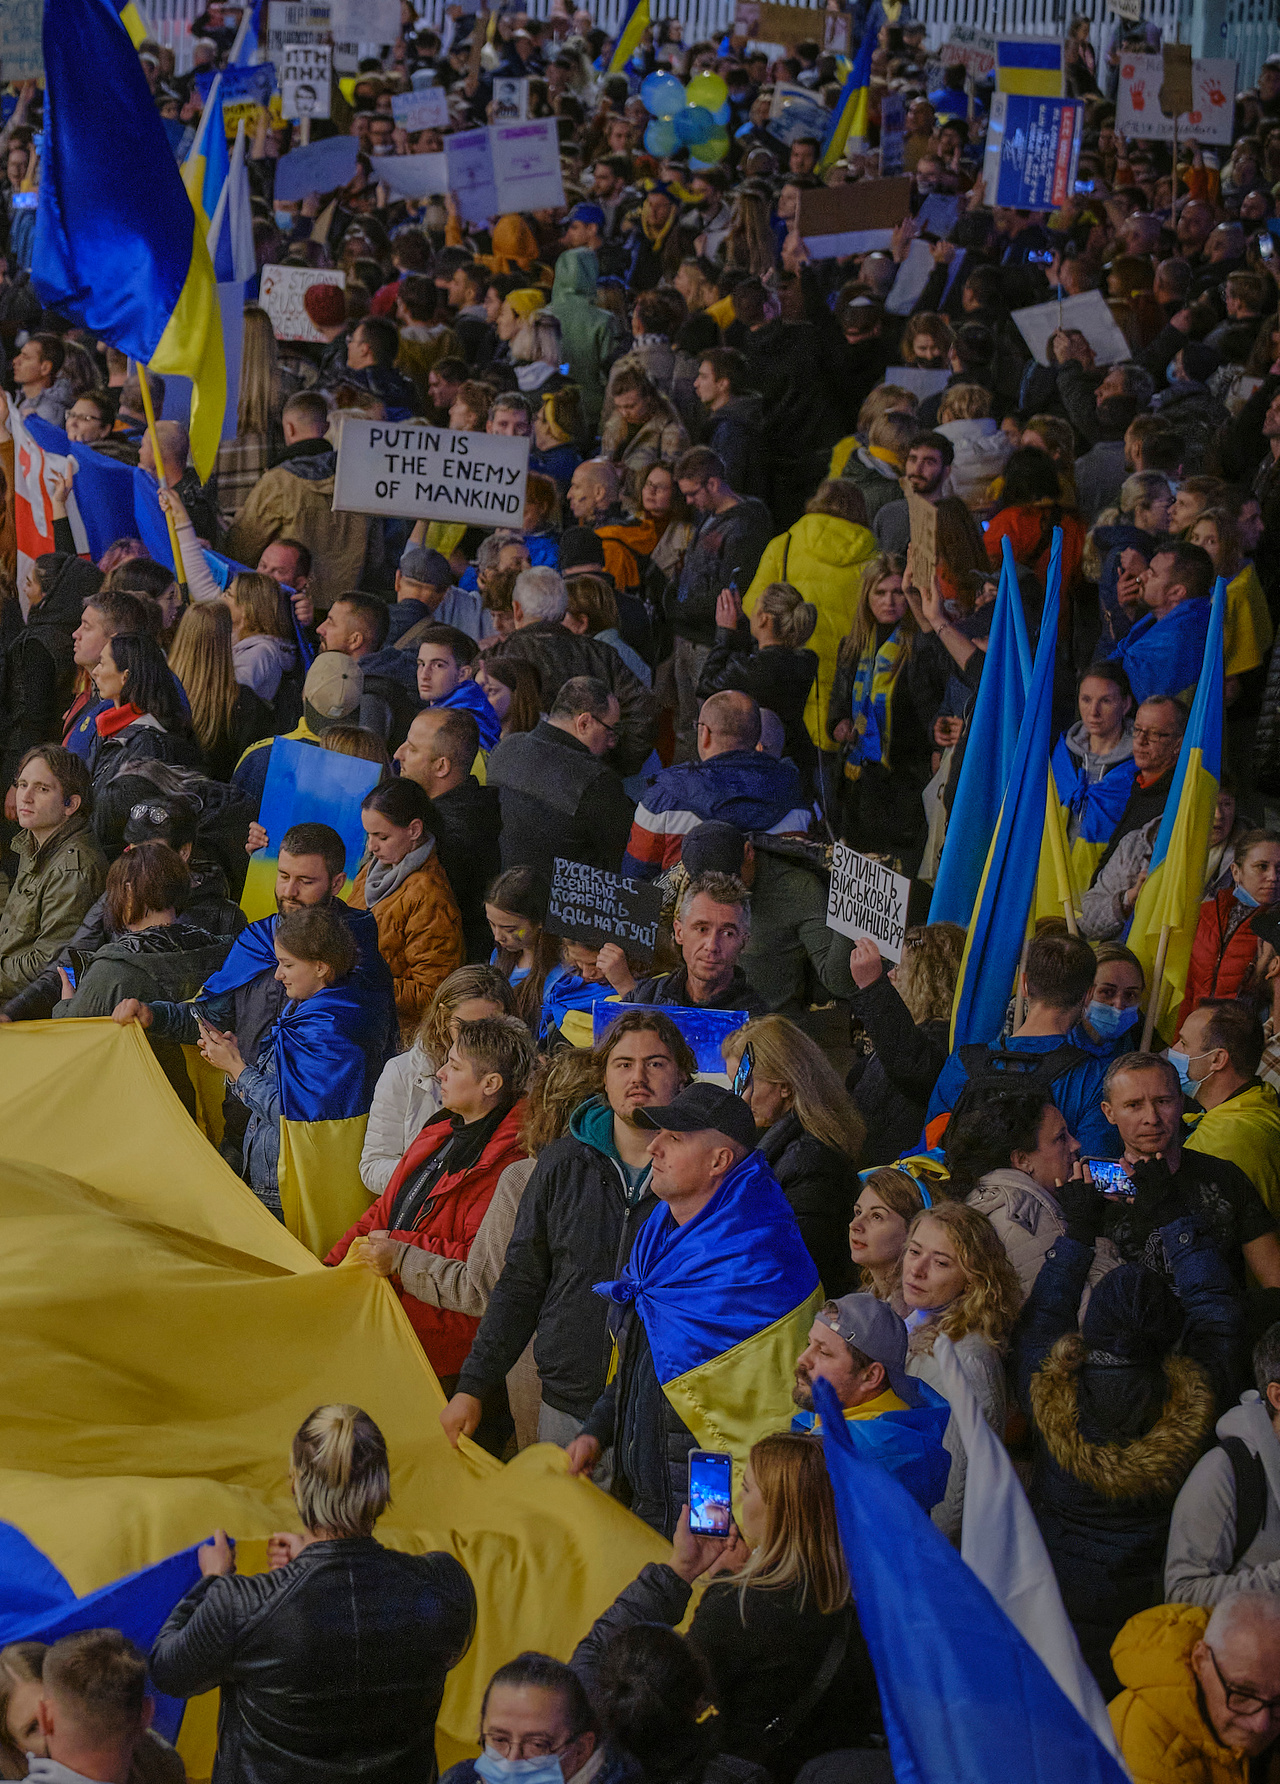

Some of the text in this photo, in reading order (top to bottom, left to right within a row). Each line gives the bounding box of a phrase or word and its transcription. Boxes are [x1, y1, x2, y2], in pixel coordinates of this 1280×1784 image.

[286, 49, 327, 65] ПТН
[285, 66, 327, 81] ПНХ
[370, 428, 469, 455] PUTIN IS
[384, 454, 521, 485] THE ENEMY
[375, 481, 520, 514] OF MANKIND
[833, 845, 898, 899] ЗУПИНІТЬ
[831, 869, 902, 922] ВІЙСЬКОВИХ
[594, 915, 612, 932] НА
[828, 891, 904, 950] ЗЛОЧИНЦІВ РФ
